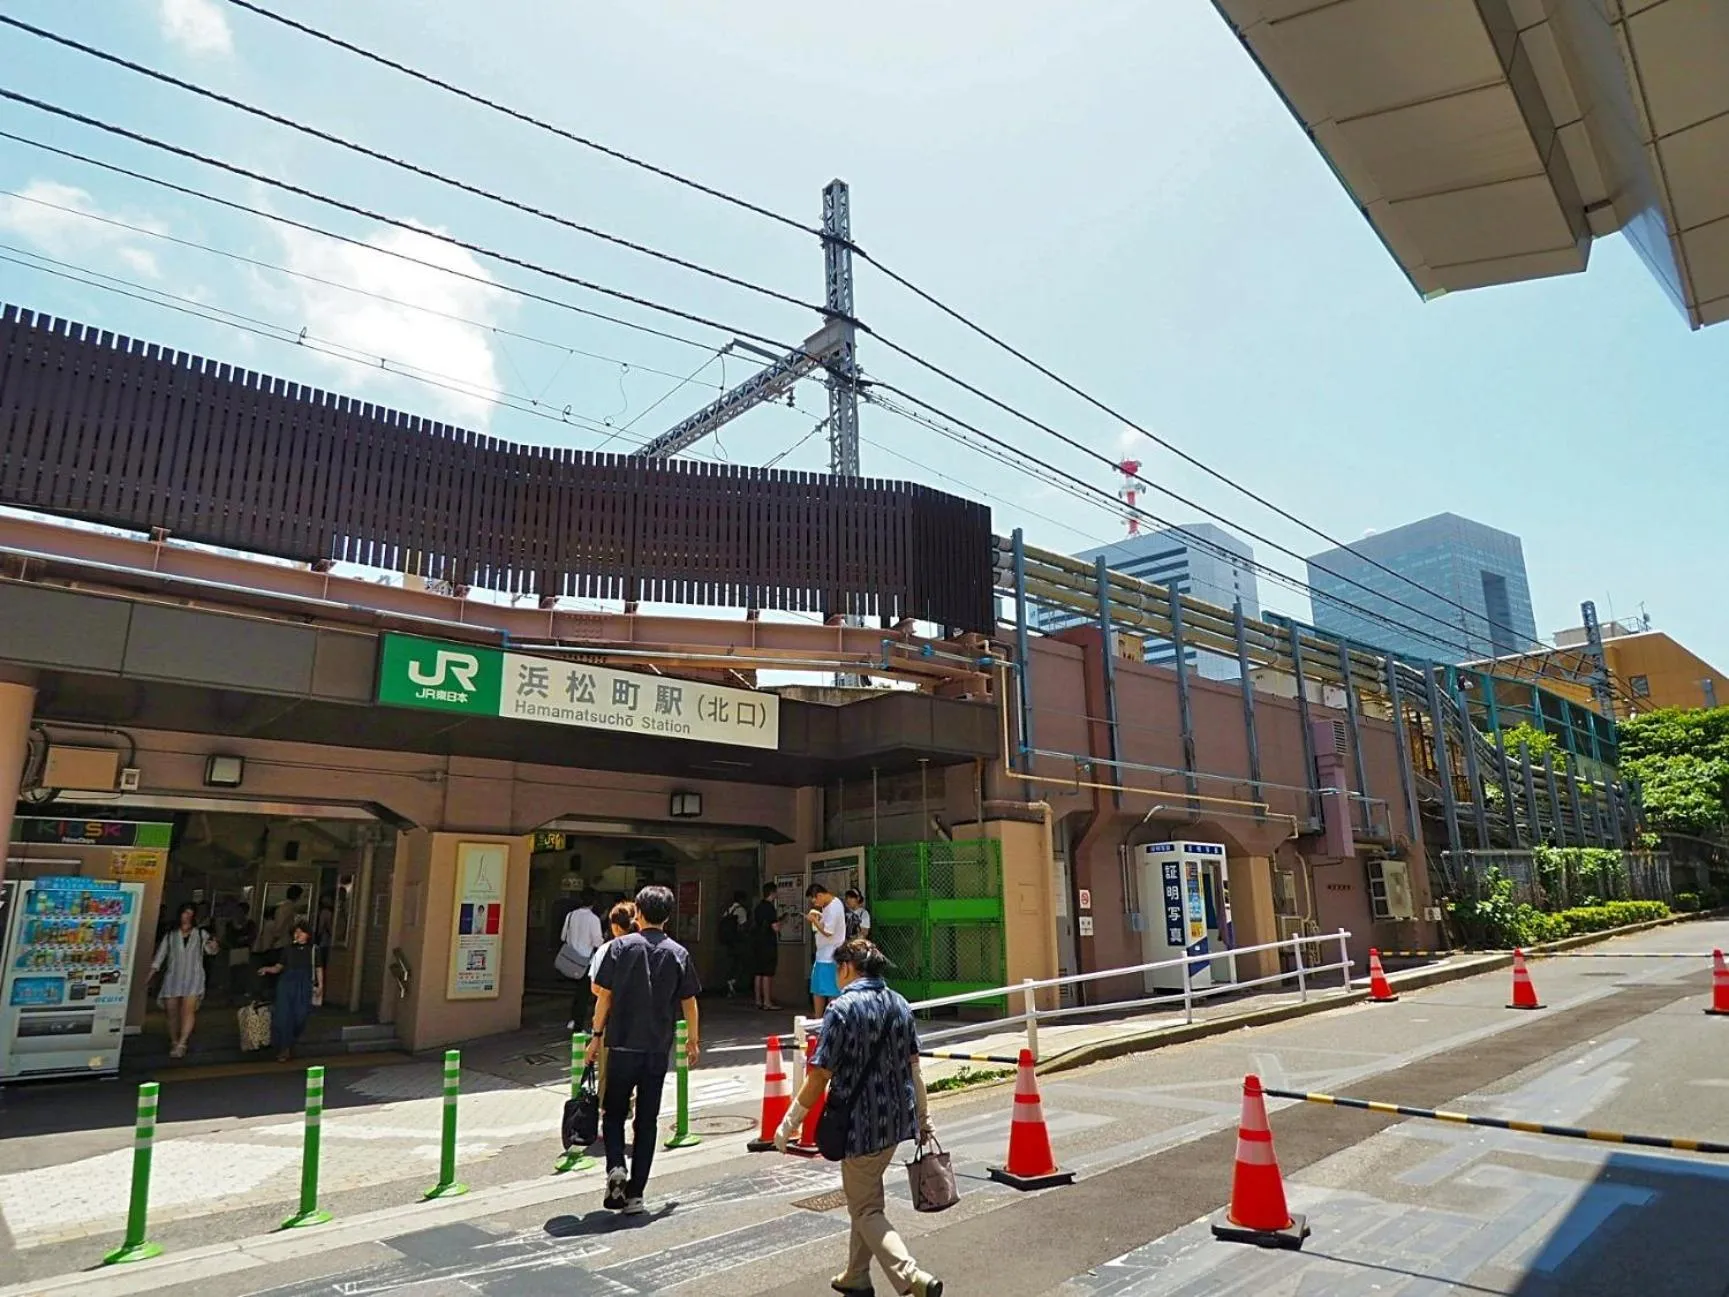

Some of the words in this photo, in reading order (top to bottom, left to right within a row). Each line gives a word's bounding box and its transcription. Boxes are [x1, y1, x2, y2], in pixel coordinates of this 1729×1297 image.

[408, 650, 480, 692] JR
[415, 688, 469, 704] JR東日本
[514, 700, 634, 728] Hamamatsuchō
[641, 716, 691, 735] Station
[36, 820, 123, 838] KIOSK
[1165, 865, 1183, 943] 証明写真
